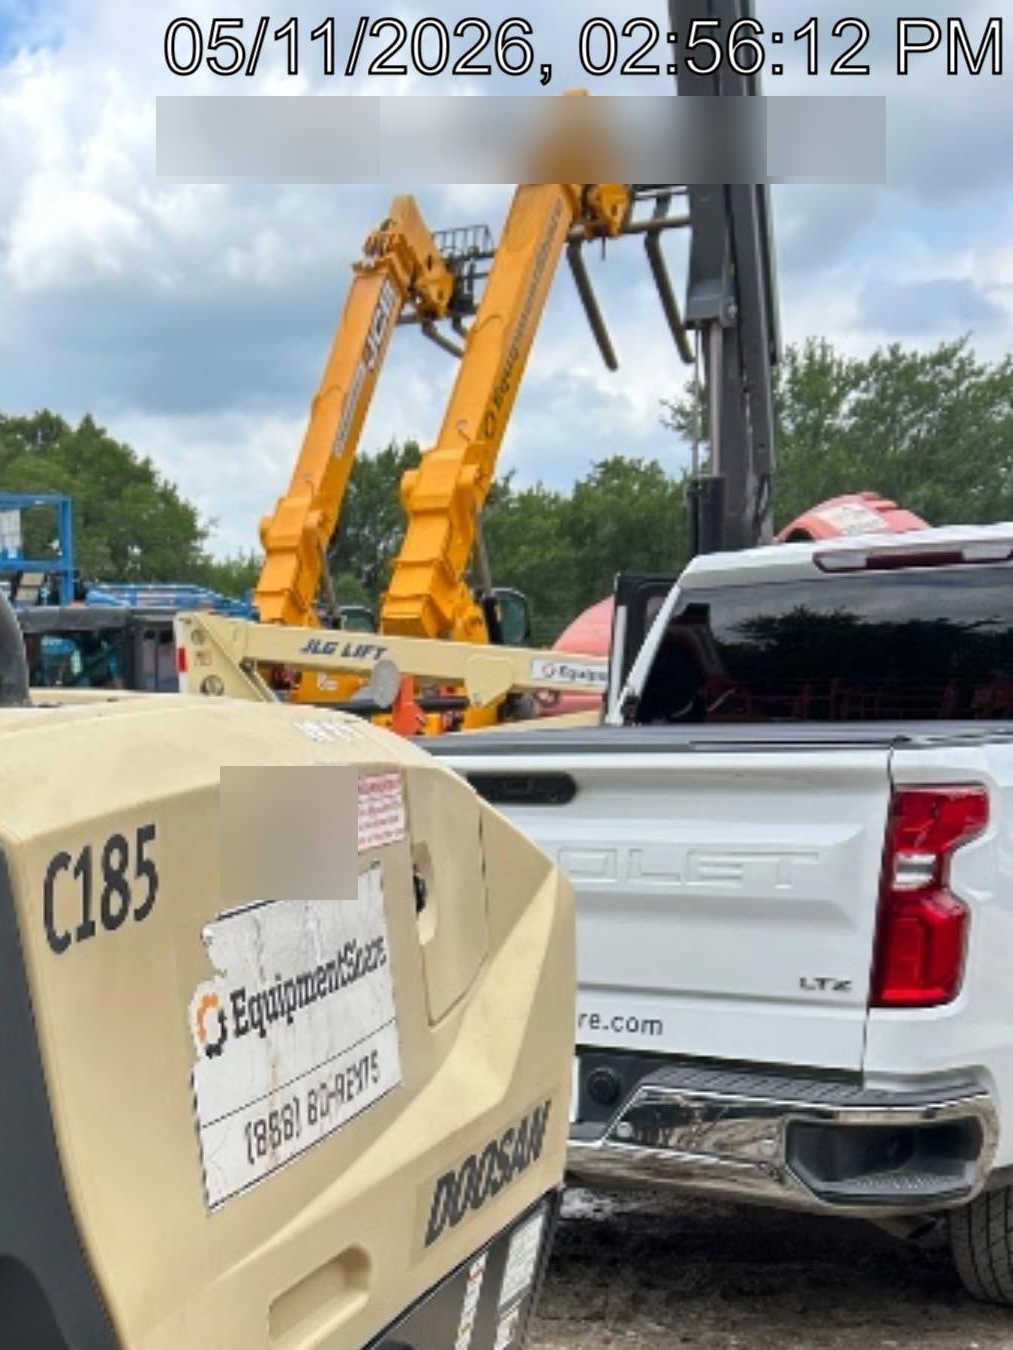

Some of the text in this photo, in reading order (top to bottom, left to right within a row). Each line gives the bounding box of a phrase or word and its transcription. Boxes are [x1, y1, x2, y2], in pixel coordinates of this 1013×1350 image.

[300, 637, 388, 660] JLG LIFT
[43, 822, 159, 955] C185
[425, 1099, 552, 1248] DOOSAN
